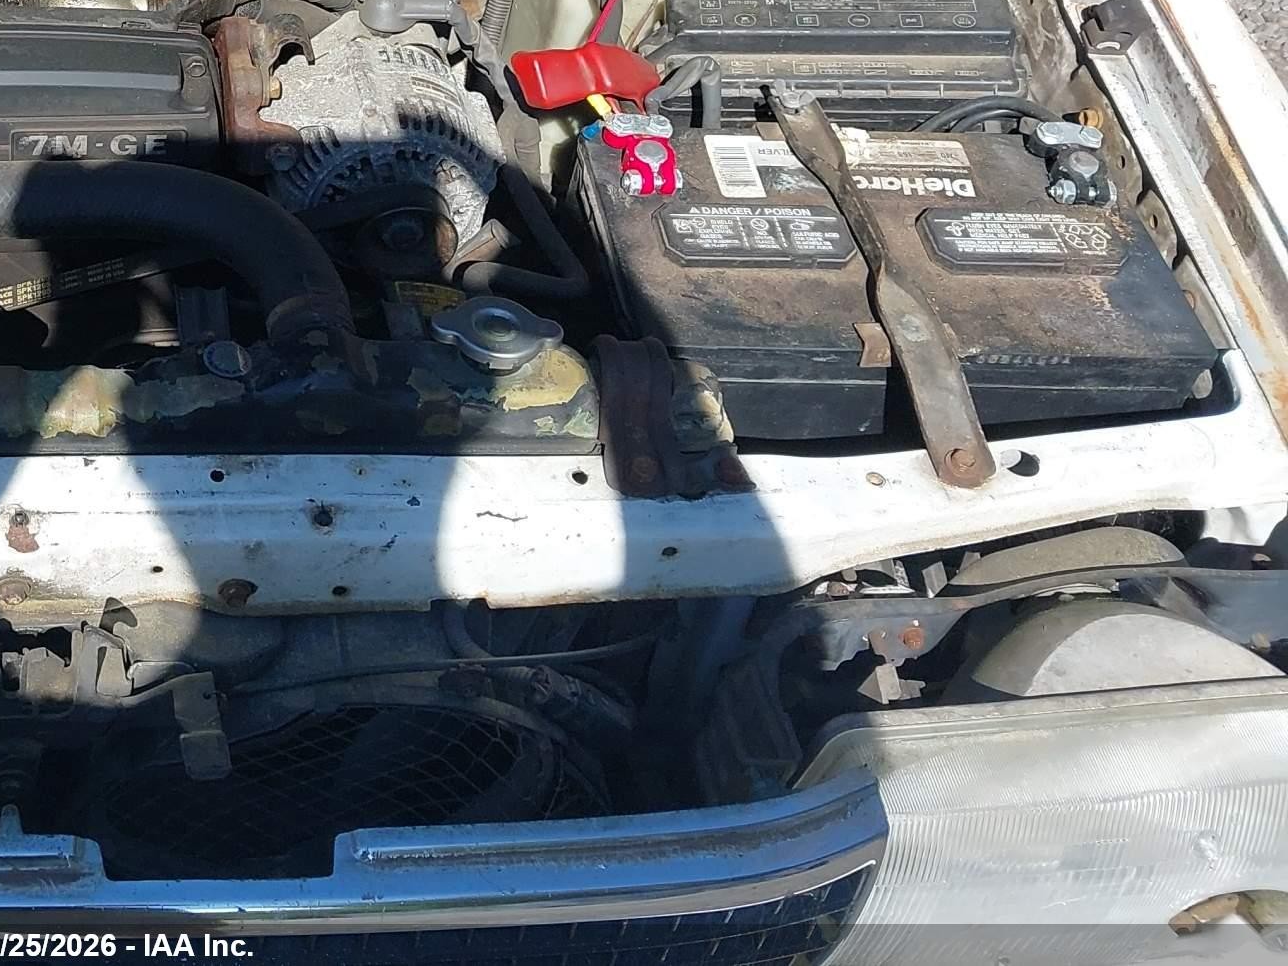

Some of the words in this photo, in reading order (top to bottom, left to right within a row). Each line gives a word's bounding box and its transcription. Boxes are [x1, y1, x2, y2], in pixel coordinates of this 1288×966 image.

[758, 148, 792, 156] ILVER
[701, 206, 753, 215] DANGER
[764, 208, 811, 216] POISON
